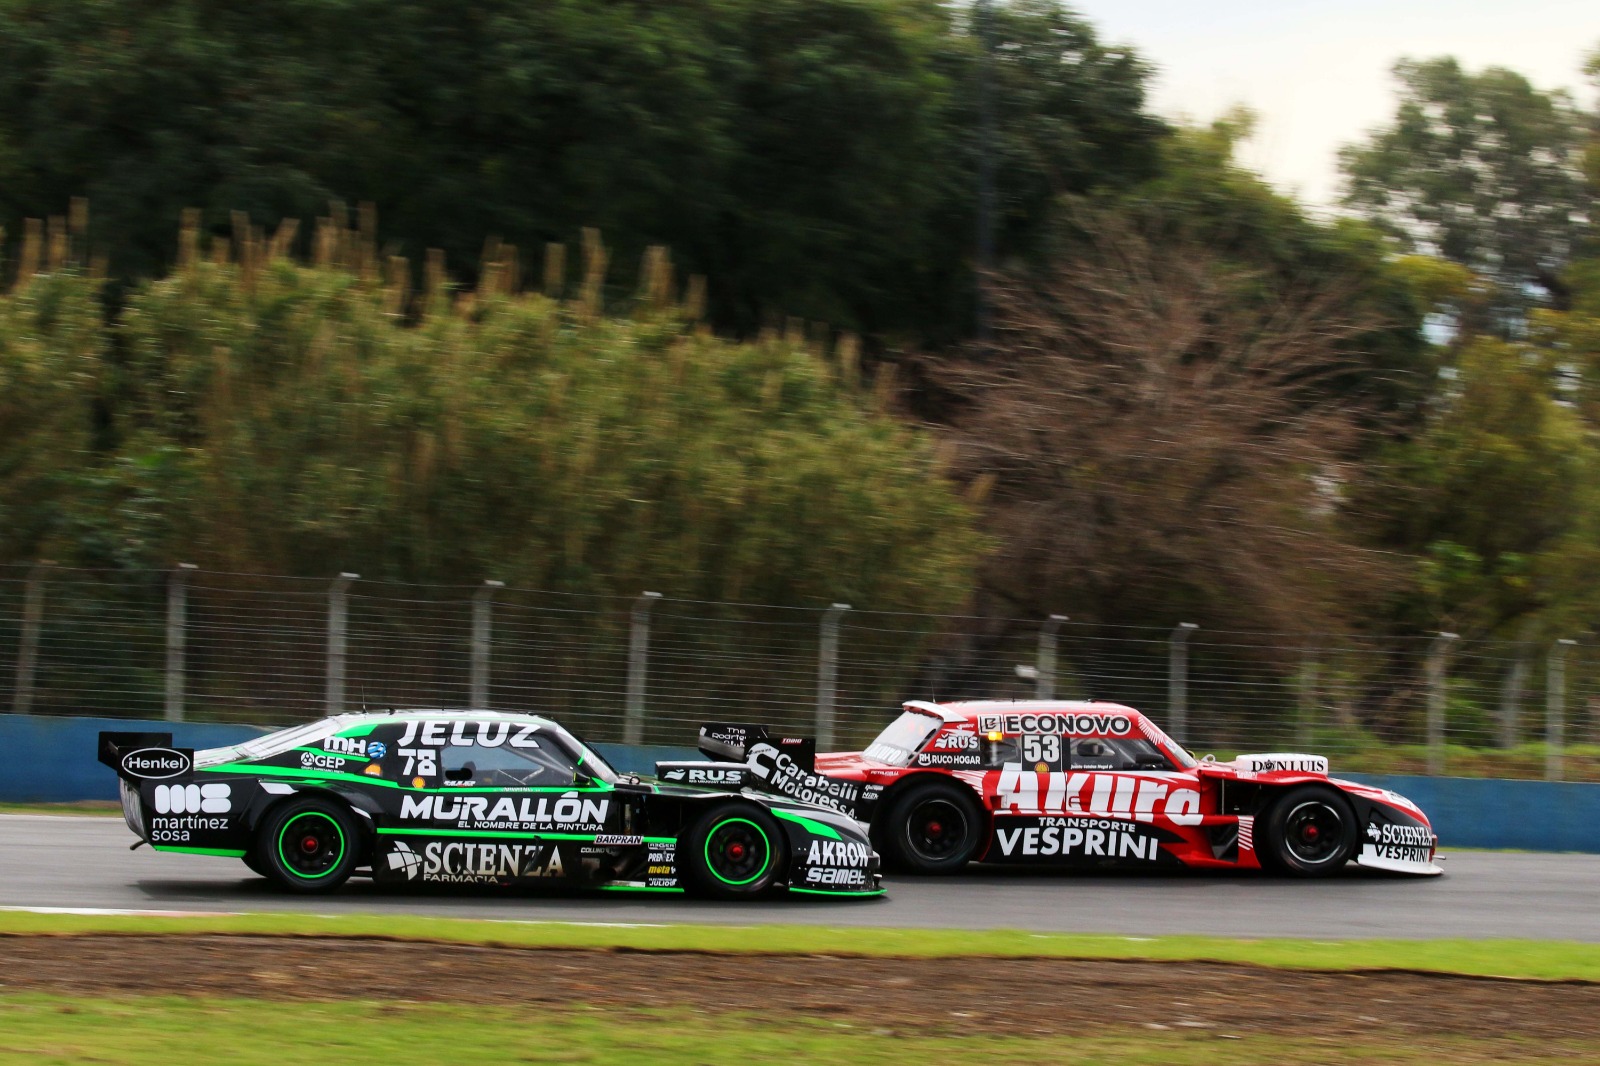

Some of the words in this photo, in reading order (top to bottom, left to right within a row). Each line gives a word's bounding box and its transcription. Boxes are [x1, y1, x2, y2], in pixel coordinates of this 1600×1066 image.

[1005, 715, 1129, 733] ECONOVO
[397, 720, 541, 748] JELUZ
[948, 736, 978, 749] RUS
[1024, 735, 1060, 762] 53
[128, 757, 184, 769] Henkel
[315, 755, 346, 769] GEP
[397, 749, 437, 776] 78
[932, 754, 953, 764] RUCO
[953, 755, 981, 765] HOGAR
[1290, 760, 1324, 773] LUIS
[689, 769, 742, 781] RUS
[775, 753, 859, 801] Carabelli
[770, 770, 840, 811] Motores
[400, 790, 609, 823] MURALLÓN
[152, 815, 229, 829] martínez
[474, 821, 520, 830] NOMBRE
[523, 822, 537, 830] DE
[540, 822, 554, 831] LA
[556, 823, 604, 832] PINTURA
[1038, 817, 1136, 833] TRANSPORTE
[152, 830, 190, 841] sosa
[596, 835, 642, 844] BARPRAN
[997, 827, 1159, 861] VESPRINI
[1382, 824, 1433, 847] SCIENZA
[423, 841, 567, 877] SCIENZA
[806, 840, 869, 867] AKRON
[1375, 843, 1429, 863] VESPRINI
[423, 873, 499, 884] FARMACIA
[806, 867, 866, 884] samet
